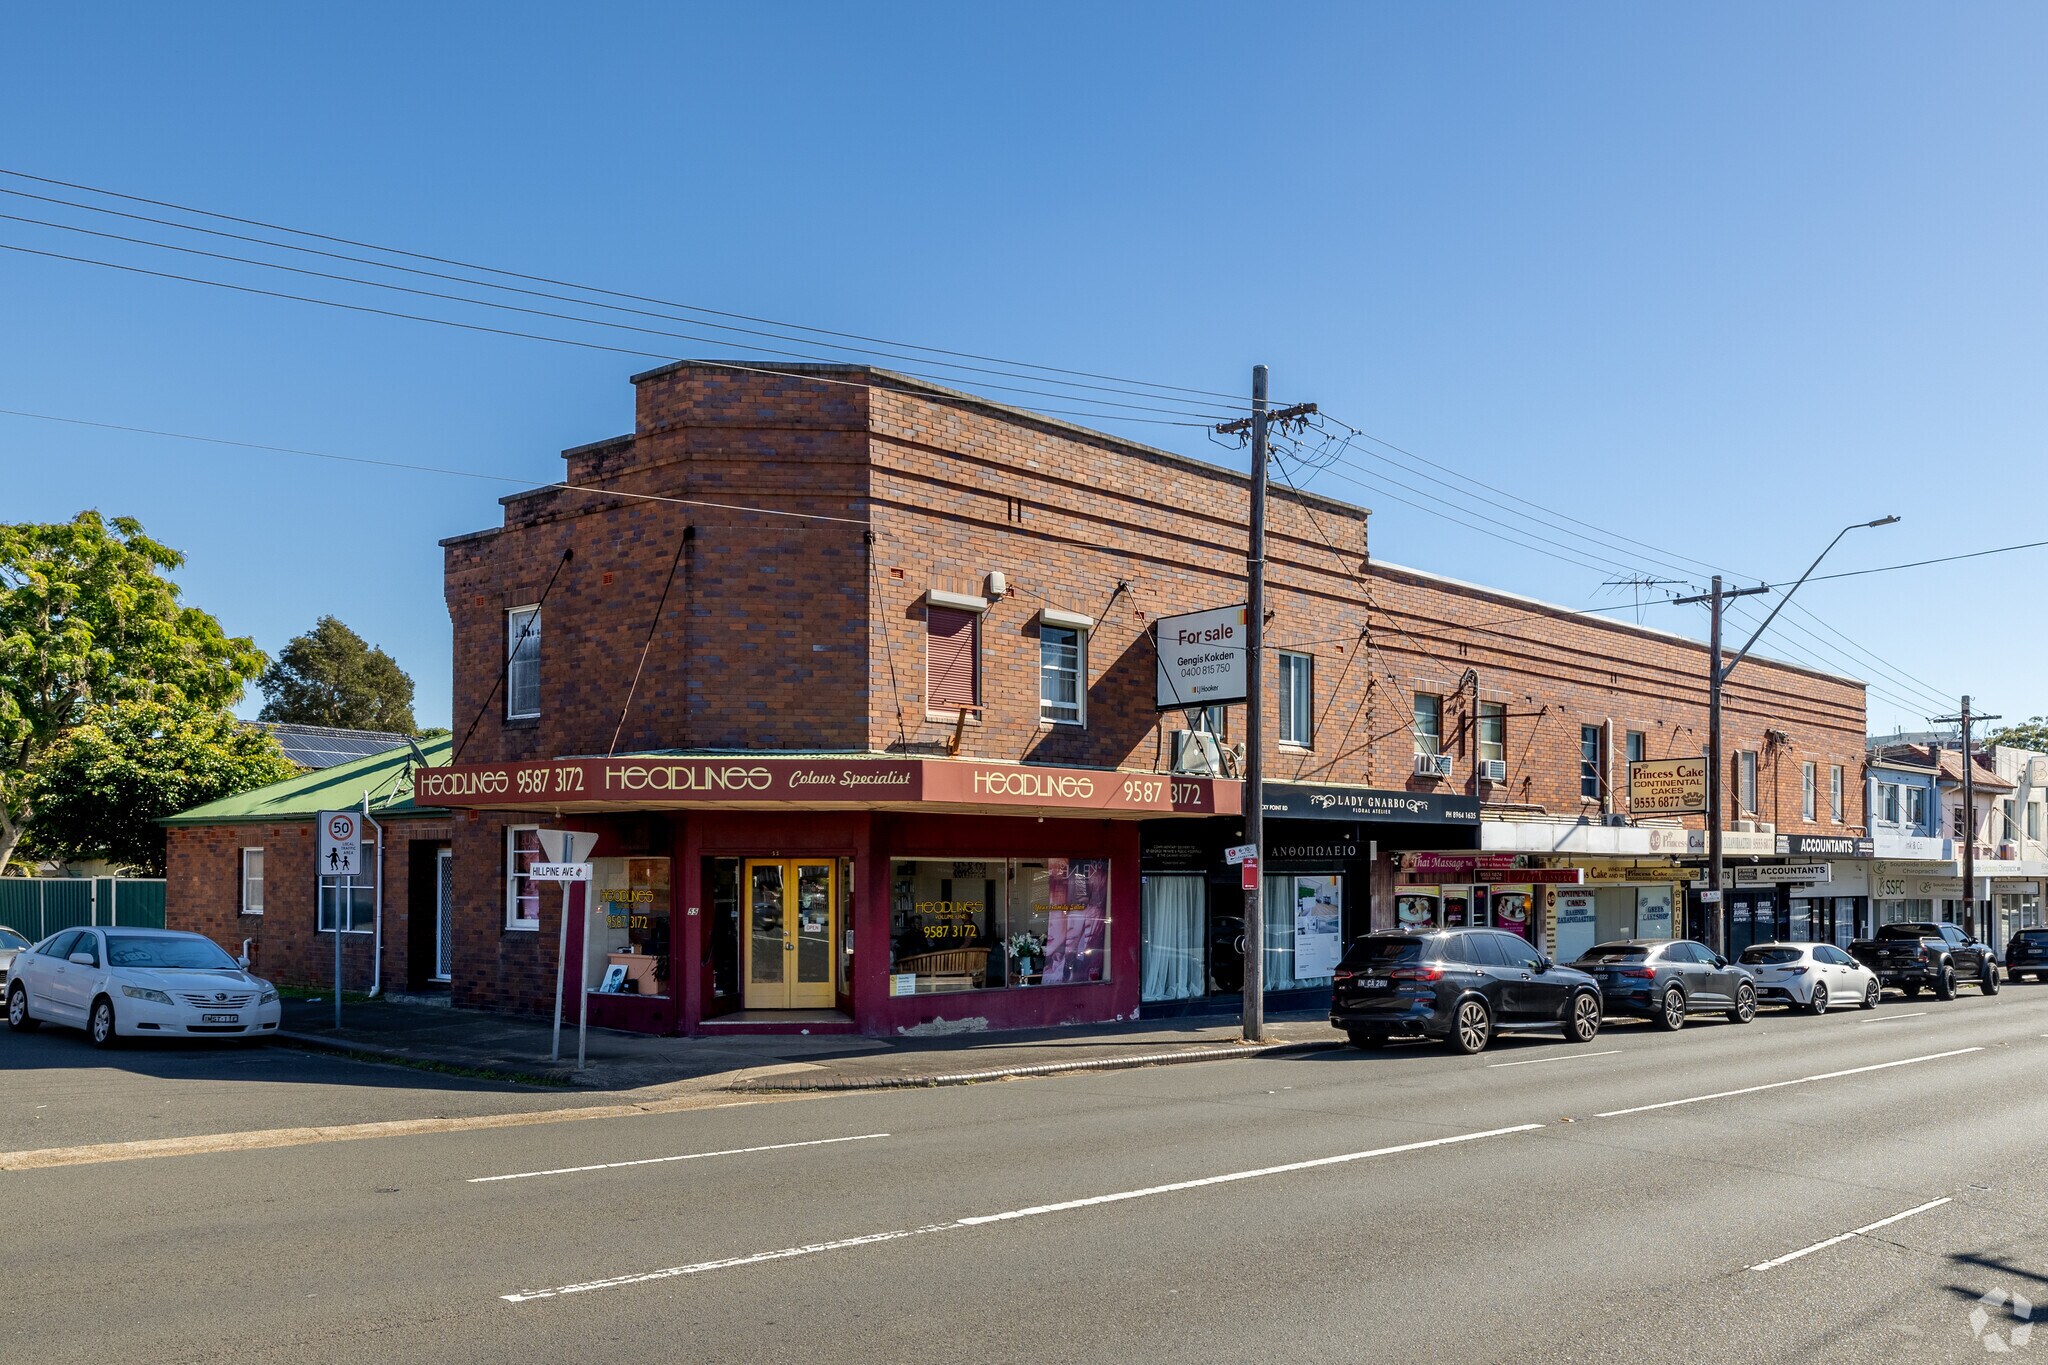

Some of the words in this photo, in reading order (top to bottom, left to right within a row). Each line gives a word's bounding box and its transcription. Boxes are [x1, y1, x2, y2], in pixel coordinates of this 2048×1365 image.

[1179, 630, 1202, 646] For
[1205, 624, 1233, 641] sale
[1177, 654, 1204, 666] Gengis
[1205, 652, 1234, 662] Kokden
[1181, 667, 1202, 678] 0400
[1202, 665, 1215, 675] 815
[1216, 663, 1231, 673] 750
[788, 769, 836, 788] Colour
[840, 769, 911, 787] Specialist
[1633, 767, 1673, 780] Princess
[1677, 765, 1704, 778] Cake
[517, 767, 549, 793] 9587
[555, 766, 584, 792] 3172
[1634, 779, 1702, 788] CONTINENTAL
[1124, 780, 1163, 804] 9587
[1170, 783, 1202, 805] 3172
[1651, 787, 1684, 795] CAKES
[1338, 795, 1364, 806] LADY
[1368, 796, 1405, 808] GNARBO
[1634, 797, 1656, 808] 9553
[1658, 796, 1680, 808] 6877
[334, 822, 349, 834] 50
[1663, 835, 1688, 848] Princess
[1689, 836, 1705, 848] Cake
[1801, 838, 1853, 854] ACCOUNTANTS
[1412, 854, 1430, 867] Thai
[1431, 857, 1464, 871] Massage
[532, 867, 560, 876] HILLPINE
[561, 867, 574, 876] AVE
[1591, 867, 1608, 880] Cake
[1652, 869, 1668, 877] Cake
[1760, 866, 1826, 875] ACCOUNTANTS
[1557, 890, 1595, 898] CONTINENTAL
[1886, 880, 1905, 895] SSFC
[607, 916, 626, 928] 9587
[630, 915, 648, 929] 3172
[1643, 913, 1670, 921] CAKESHOP
[924, 925, 949, 938] 9587
[952, 924, 977, 938] 3172
